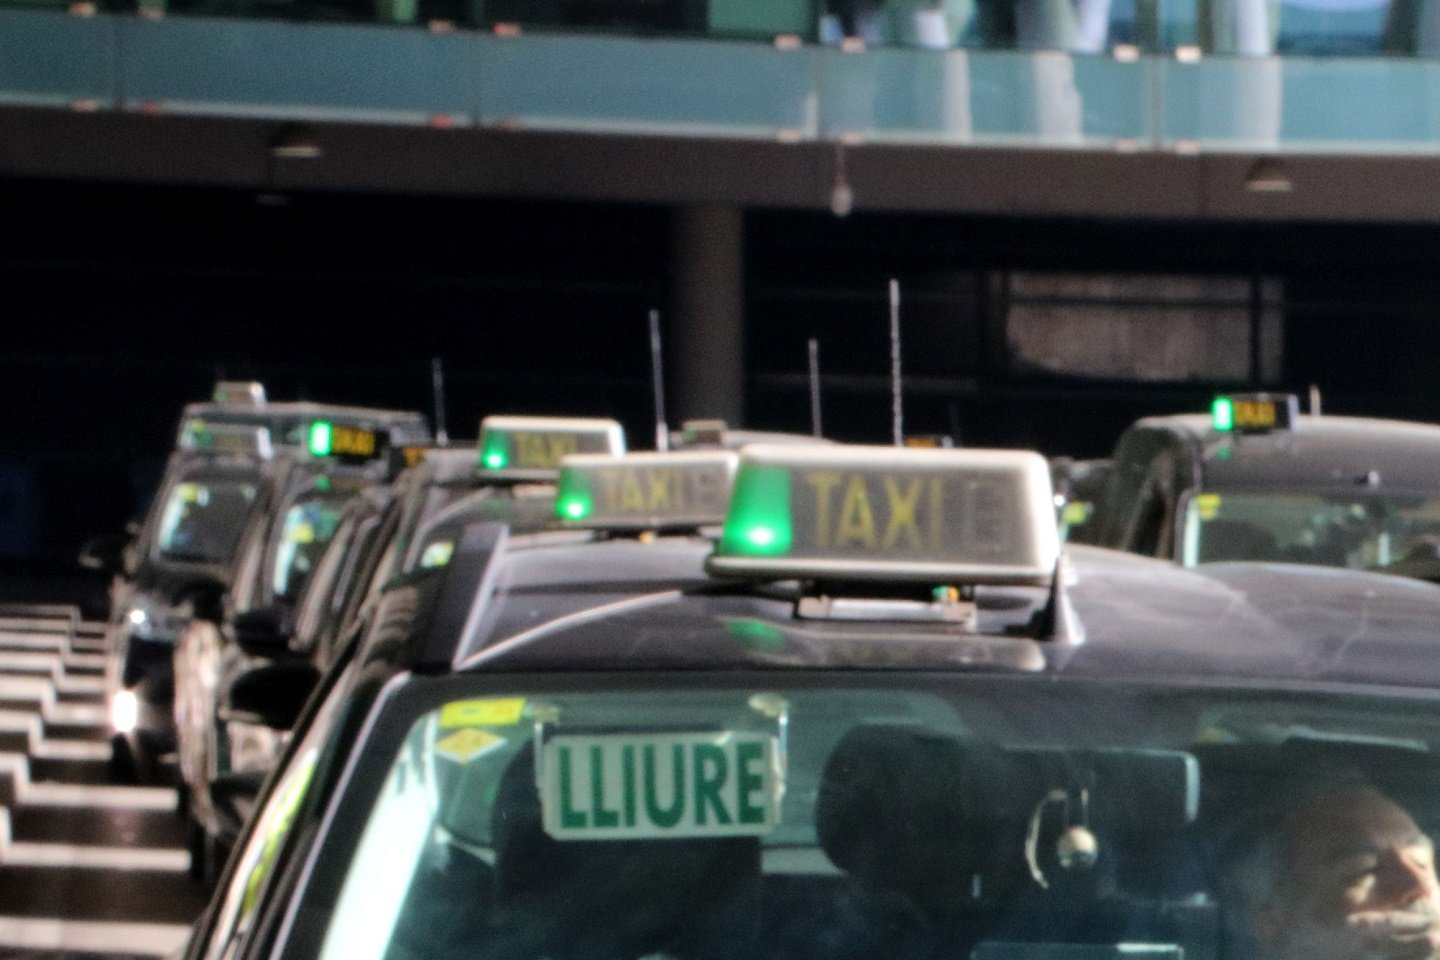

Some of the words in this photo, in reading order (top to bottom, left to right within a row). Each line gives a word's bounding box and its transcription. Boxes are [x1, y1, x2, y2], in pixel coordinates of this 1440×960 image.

[602, 468, 684, 511] TAXI
[808, 474, 945, 550] TAXI
[559, 742, 765, 829] LLIURE
